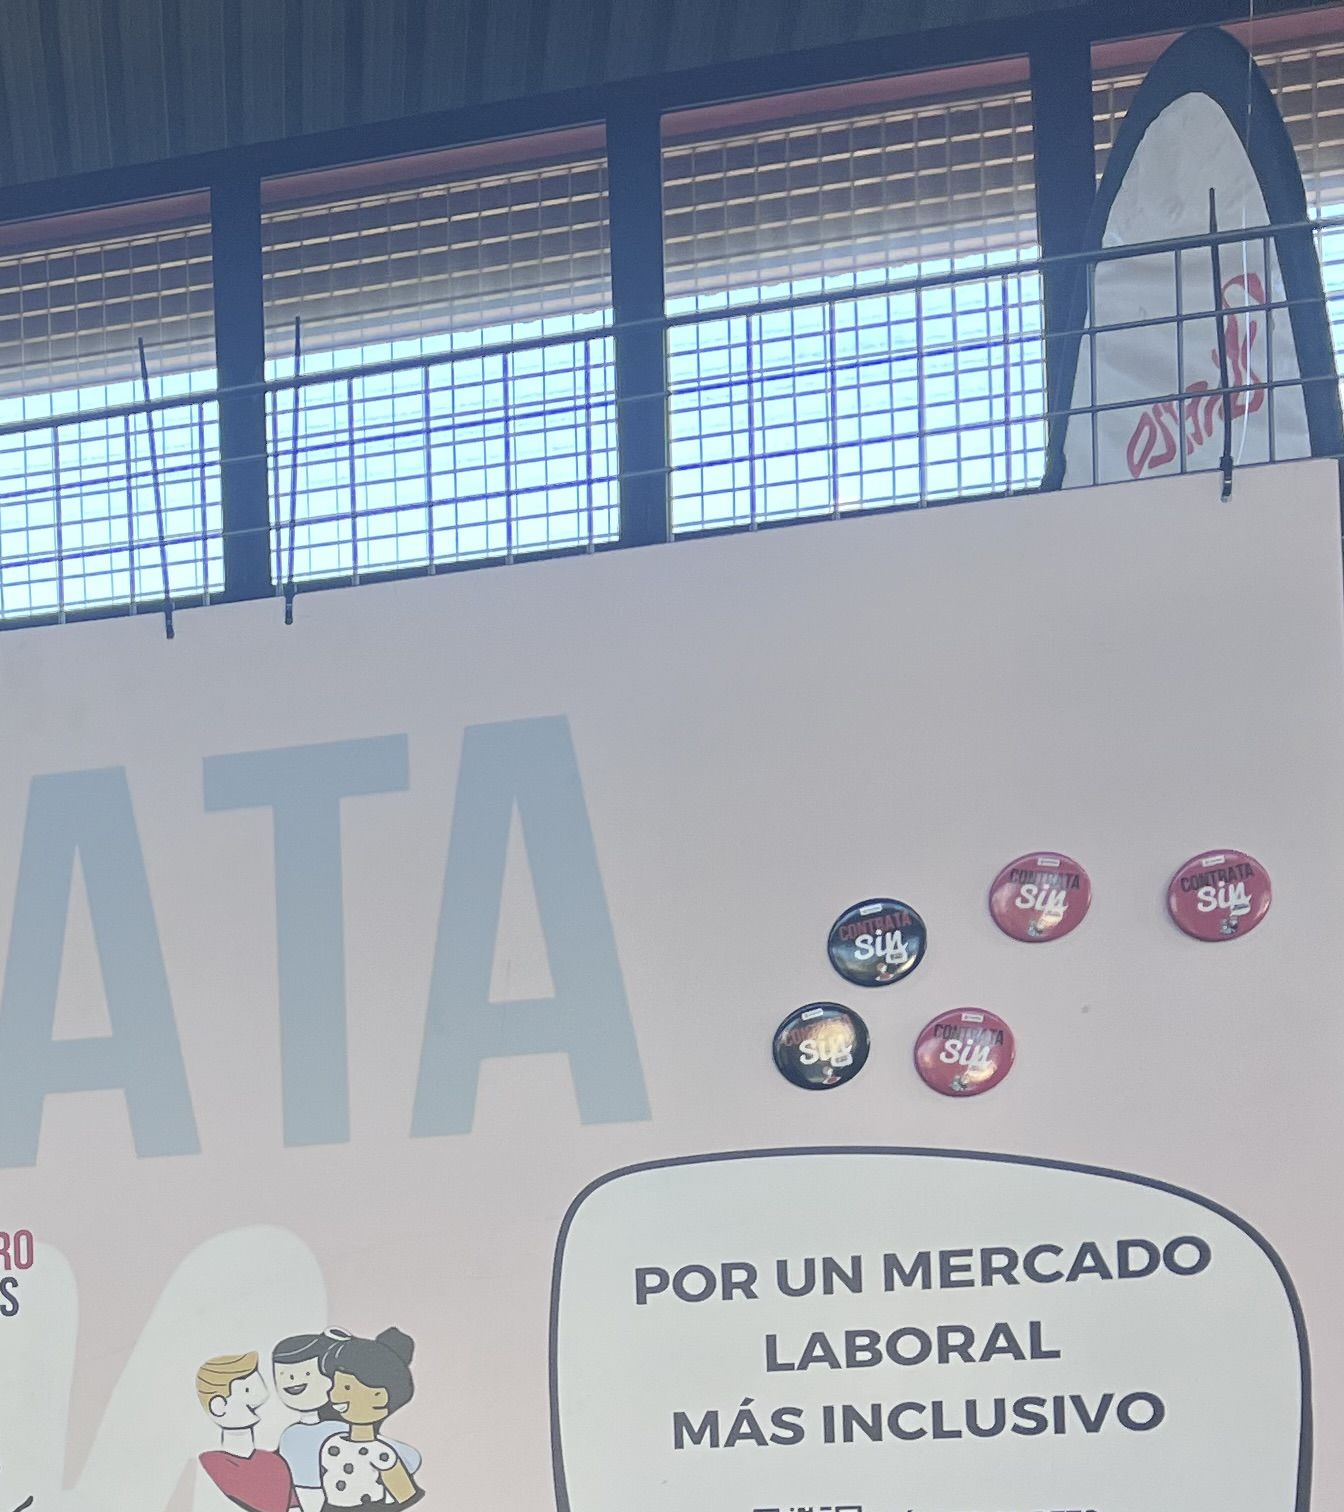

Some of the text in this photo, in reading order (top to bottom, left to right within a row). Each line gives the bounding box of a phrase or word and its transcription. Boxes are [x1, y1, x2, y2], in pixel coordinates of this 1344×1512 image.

[634, 1235, 1212, 1305] POR UN MERCADO
[765, 1320, 1061, 1372] LABORAL
[672, 1390, 1166, 1450] MÁS INCLUSIVO
